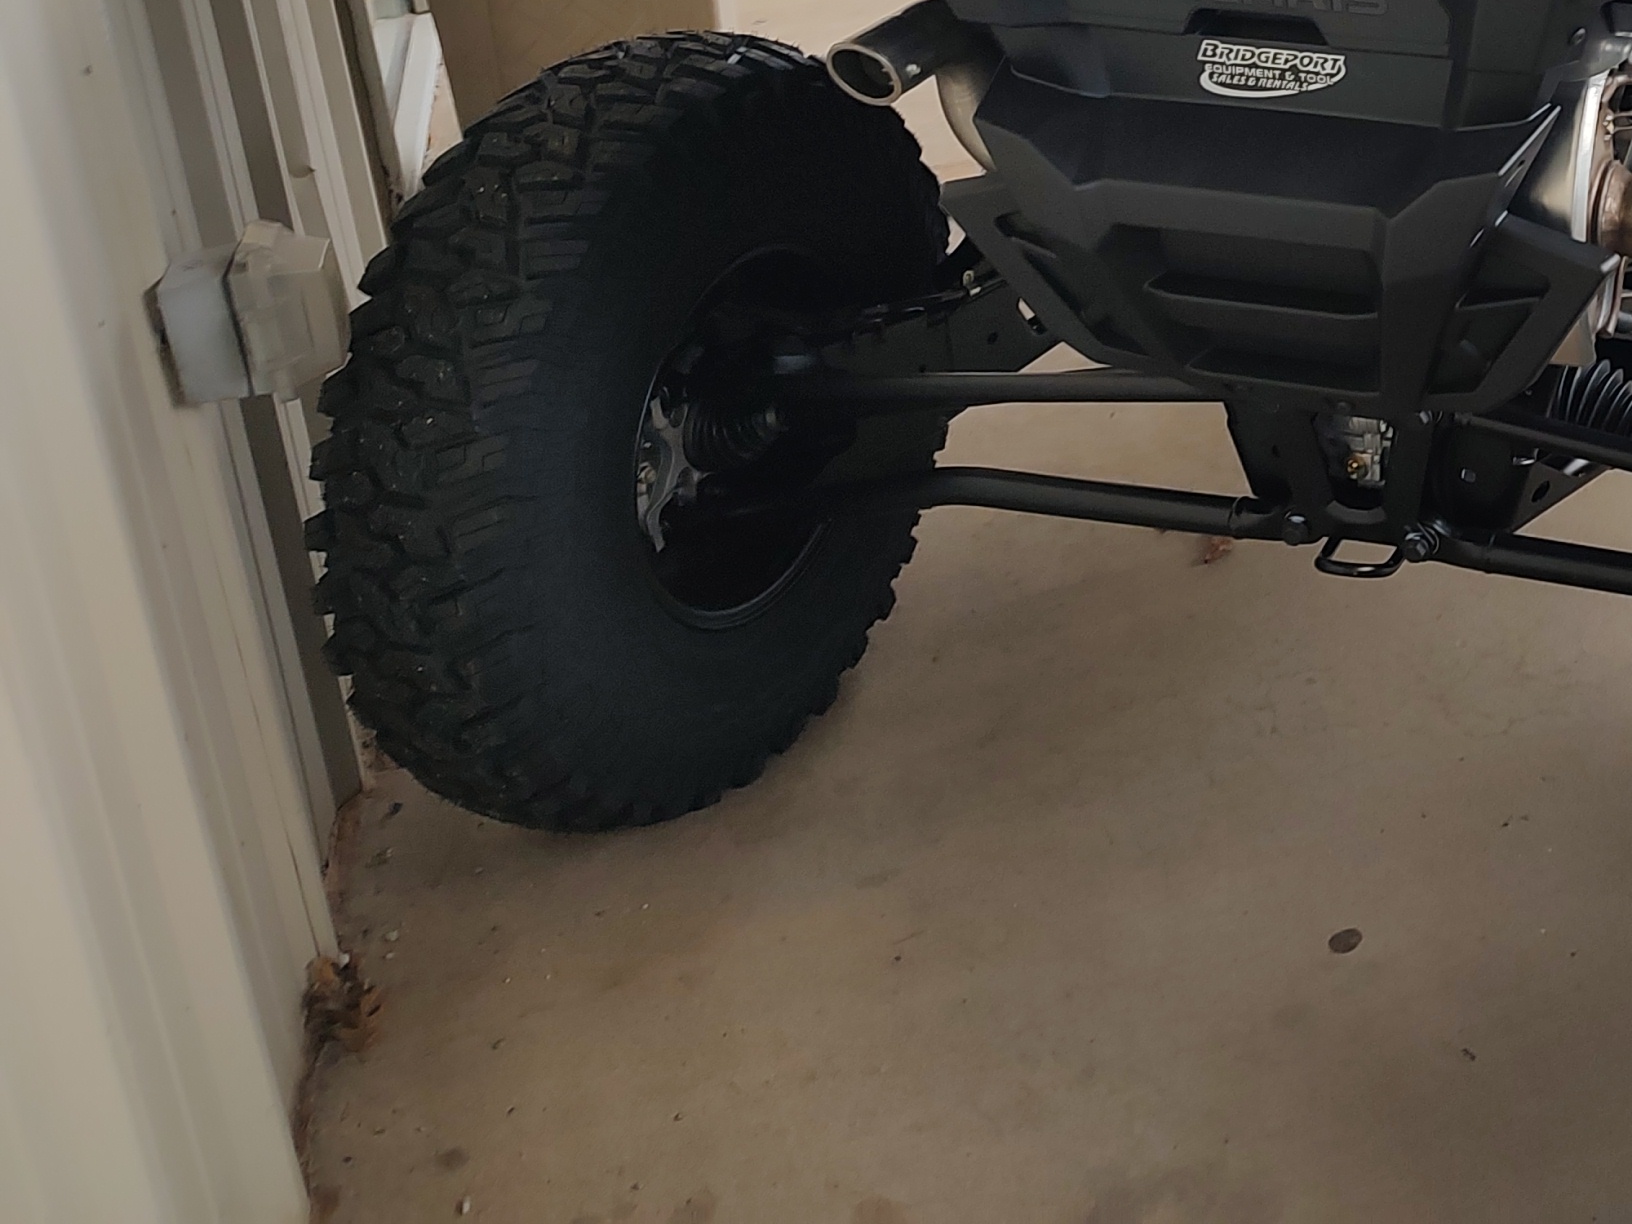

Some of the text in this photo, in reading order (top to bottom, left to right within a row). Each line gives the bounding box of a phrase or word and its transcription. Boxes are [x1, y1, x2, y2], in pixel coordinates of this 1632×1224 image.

[1199, 41, 1343, 73] BRIDGEPORT
[1204, 63, 1334, 85] EQUIPMENT & TOOL
[1212, 74, 1309, 91] SALES & RENTALS
